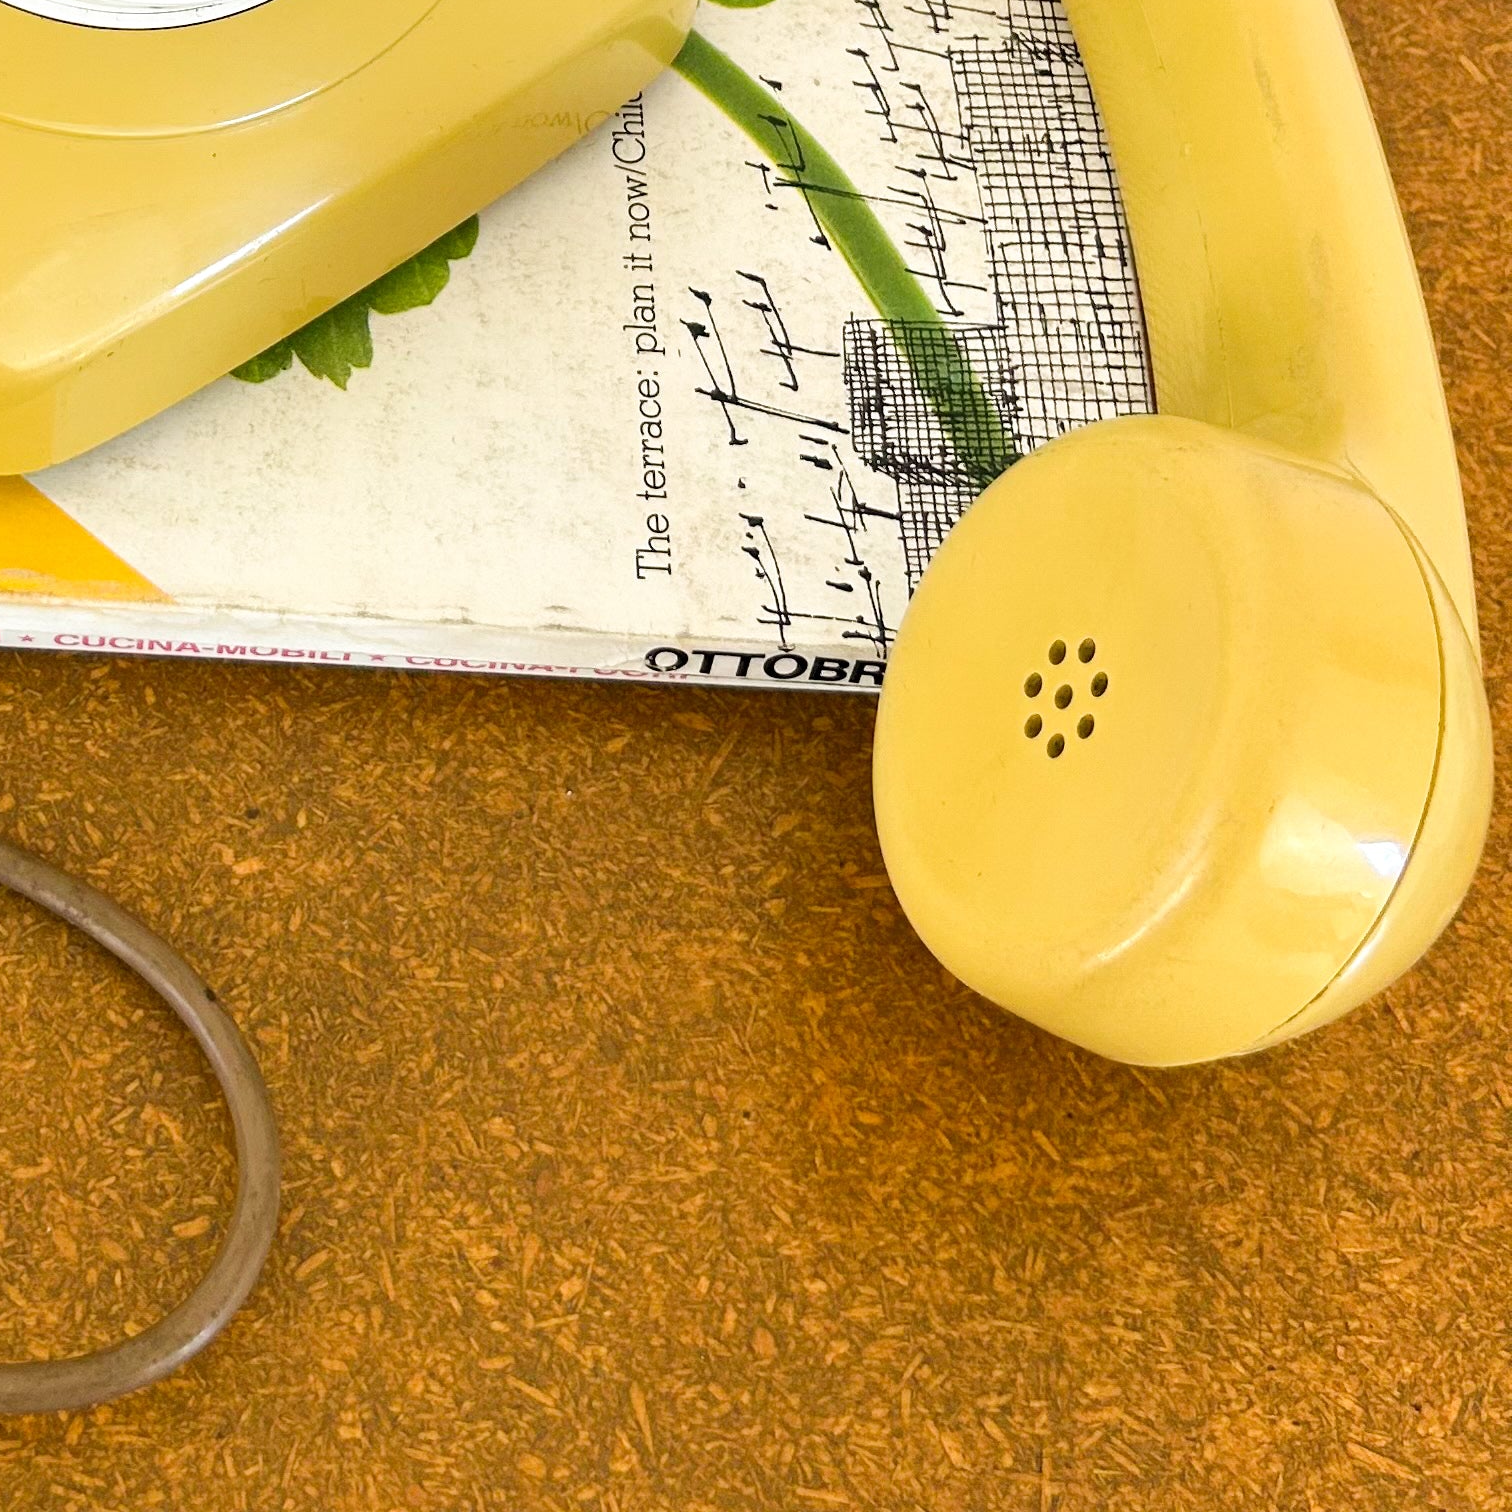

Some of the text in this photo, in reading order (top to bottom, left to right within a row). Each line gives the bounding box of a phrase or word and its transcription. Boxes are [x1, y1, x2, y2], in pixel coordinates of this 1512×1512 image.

[623, 253, 653, 273] it
[622, 283, 666, 357] plan
[636, 370, 670, 498] terrace:
[634, 507, 673, 580] The
